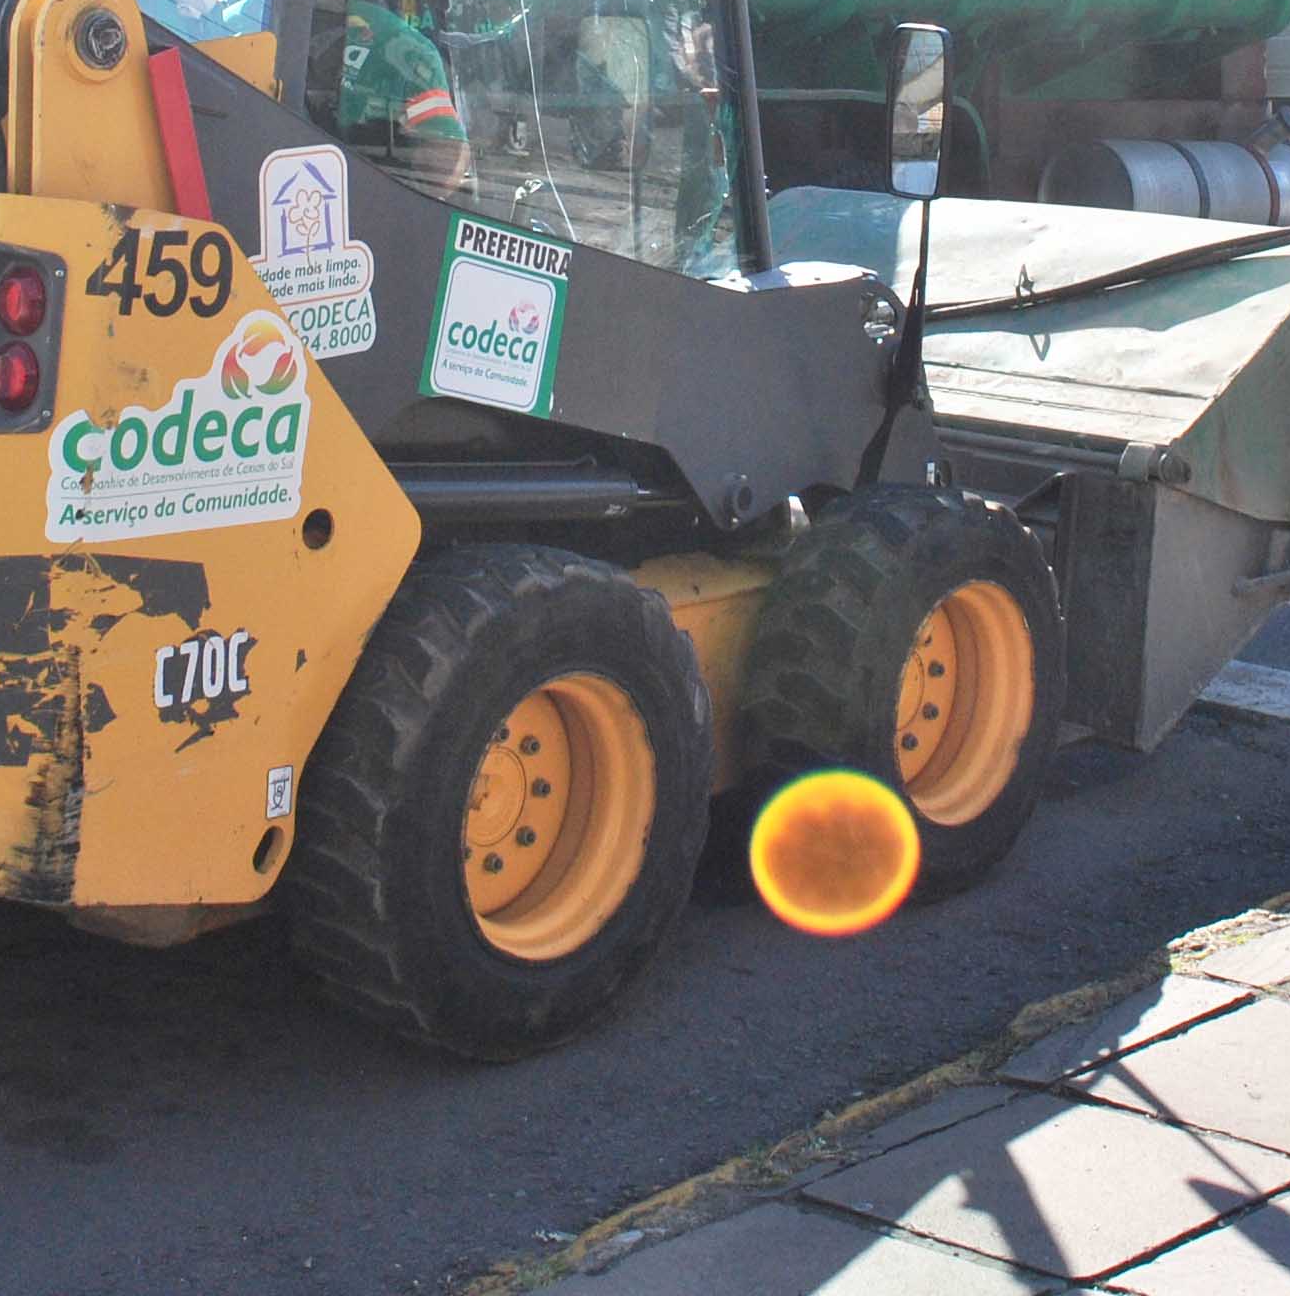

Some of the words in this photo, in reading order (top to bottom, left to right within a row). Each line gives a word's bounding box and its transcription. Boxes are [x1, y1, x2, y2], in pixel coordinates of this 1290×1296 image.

[253, 266, 292, 283] idade
[295, 260, 322, 278] mais
[326, 257, 362, 275] limpa.
[459, 223, 572, 276] PREFEITURA
[85, 228, 233, 318] 459
[297, 279, 325, 296] mais
[329, 273, 360, 289] linda.
[288, 297, 371, 333] CODECA
[447, 320, 538, 365] codeca
[62, 390, 302, 474] codeca
[61, 475, 125, 492] Copanhia
[127, 474, 139, 488] de
[222, 464, 235, 476] de
[59, 503, 76, 525] A
[84, 507, 148, 528] serviço
[155, 497, 175, 518] da
[182, 484, 293, 514] Comunidade.
[154, 631, 249, 708] C70C
